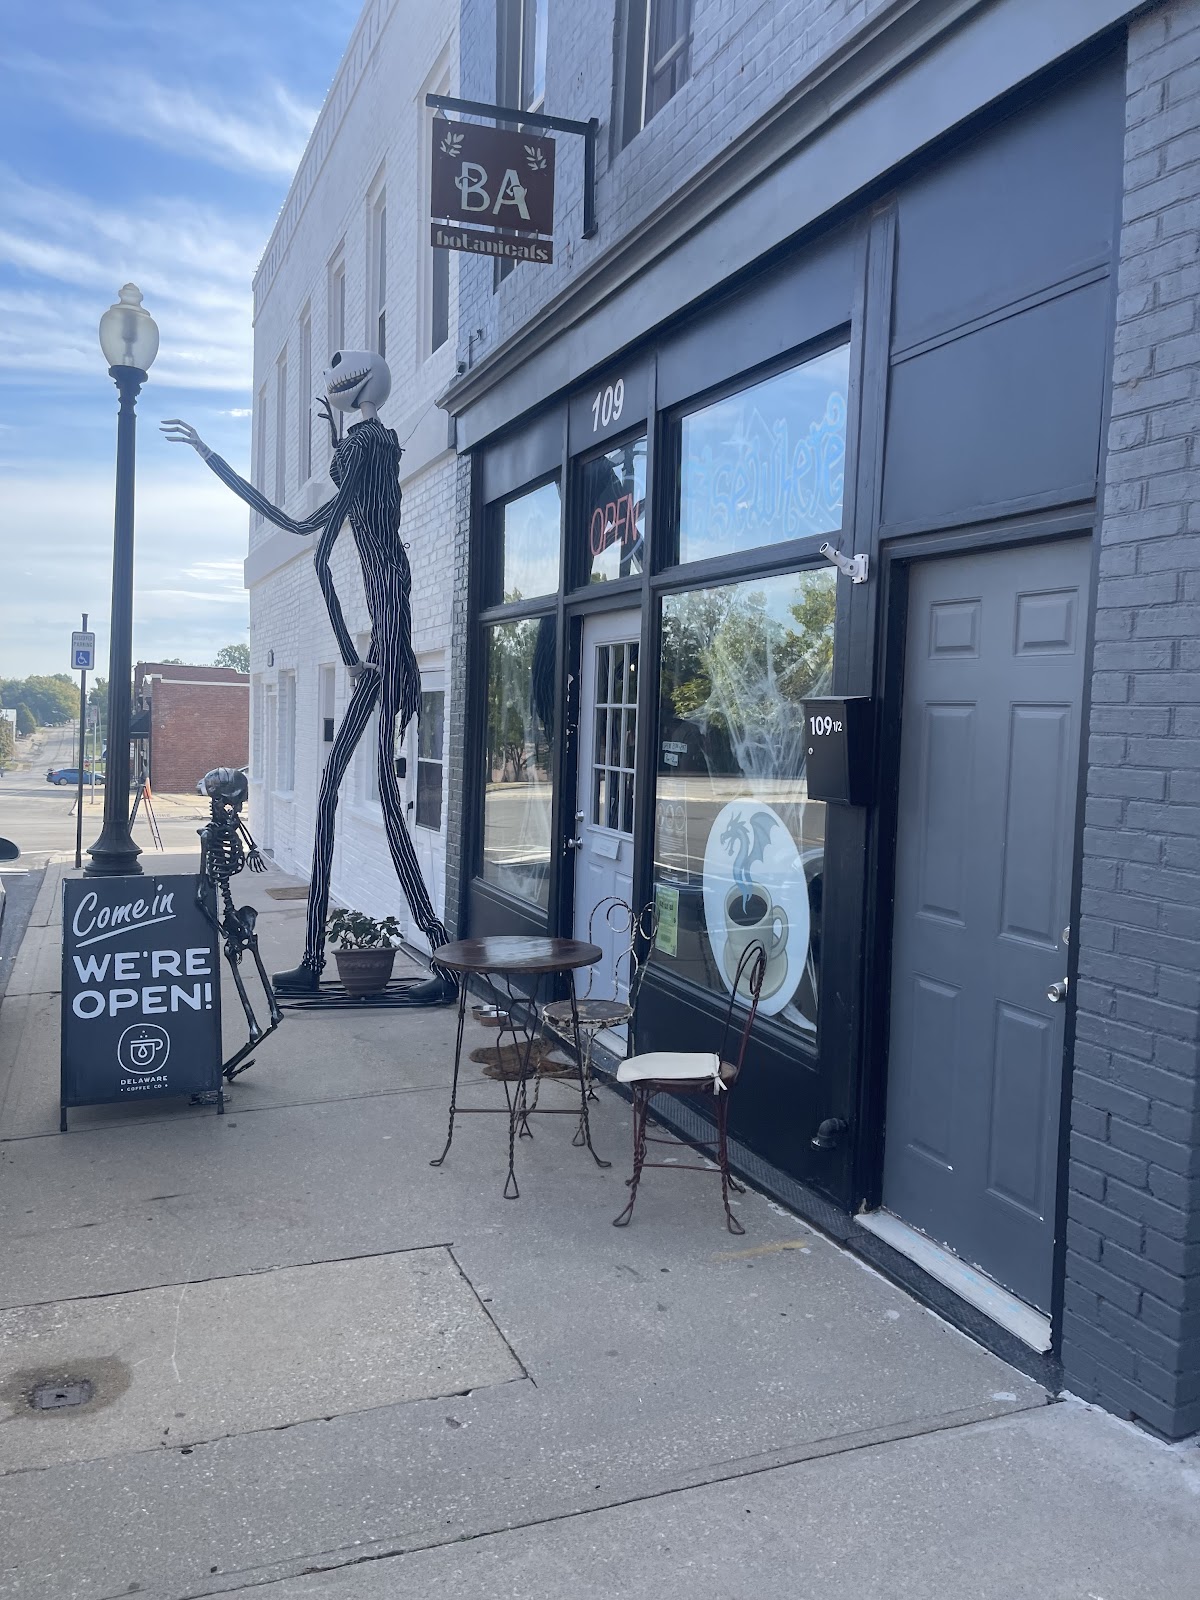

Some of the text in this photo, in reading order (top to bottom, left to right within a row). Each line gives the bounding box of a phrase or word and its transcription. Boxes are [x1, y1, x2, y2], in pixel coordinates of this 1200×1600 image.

[454, 161, 531, 220] BA
[436, 230, 549, 261] botanicals
[591, 378, 625, 433] 109
[590, 493, 640, 556] OPEN
[810, 715, 832, 736] 109
[72, 884, 175, 937] Come in
[72, 947, 212, 984] WE'RE
[72, 982, 213, 1019] OPEN!
[120, 1075, 168, 1085] DELAWARE
